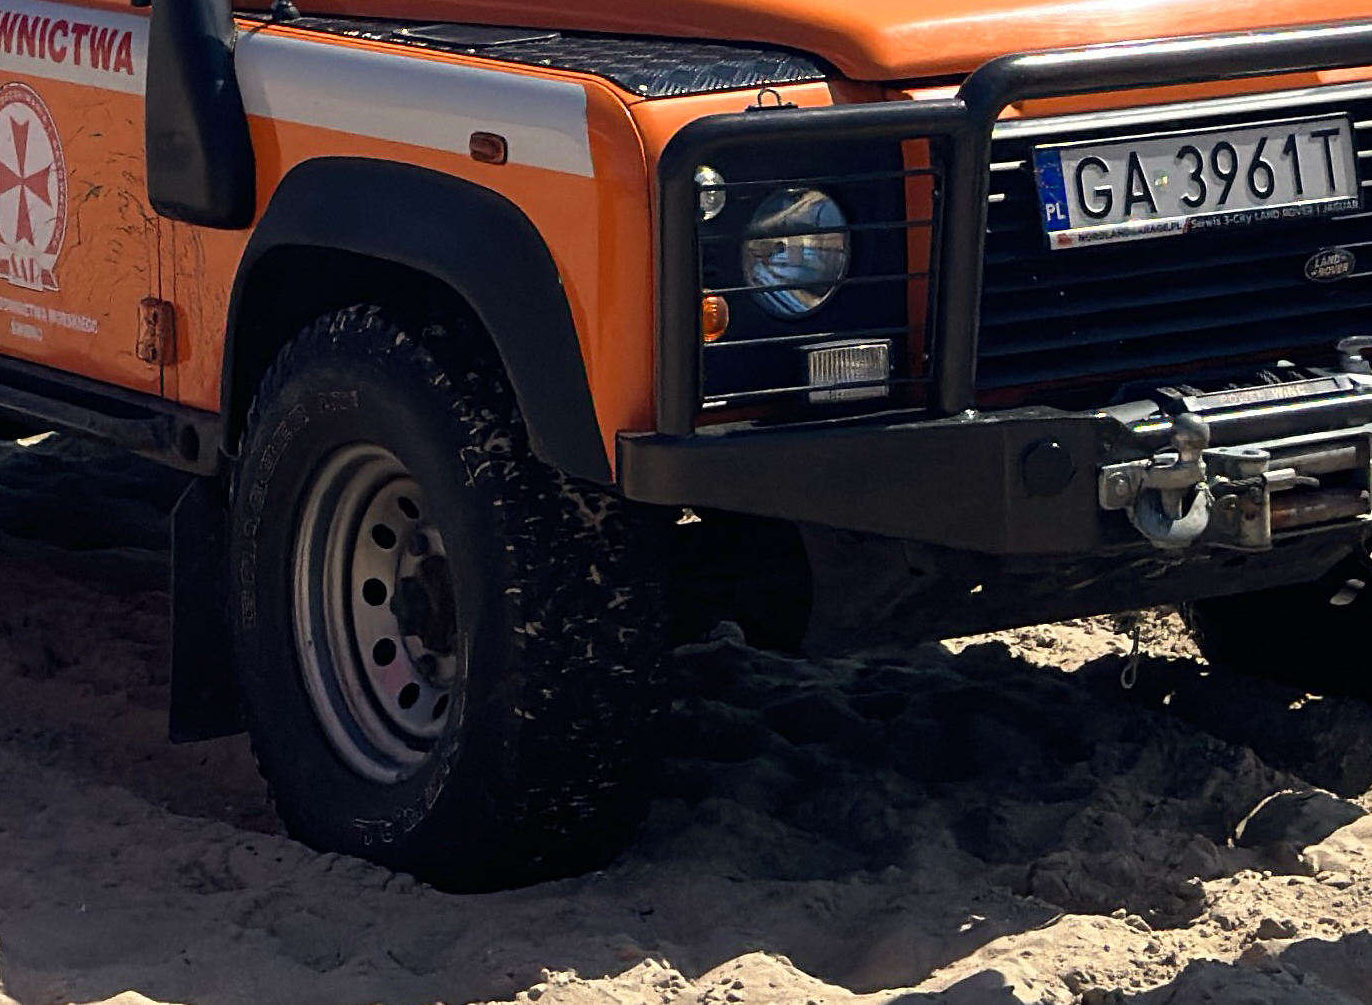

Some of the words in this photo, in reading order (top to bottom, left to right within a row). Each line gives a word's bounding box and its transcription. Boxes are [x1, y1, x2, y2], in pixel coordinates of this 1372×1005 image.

[1074, 149, 1159, 220] GA
[1176, 129, 1340, 208] 3961T
[1045, 202, 1067, 222] PL
[1223, 213, 1253, 225] 3-City
[1314, 253, 1342, 269] LAND
